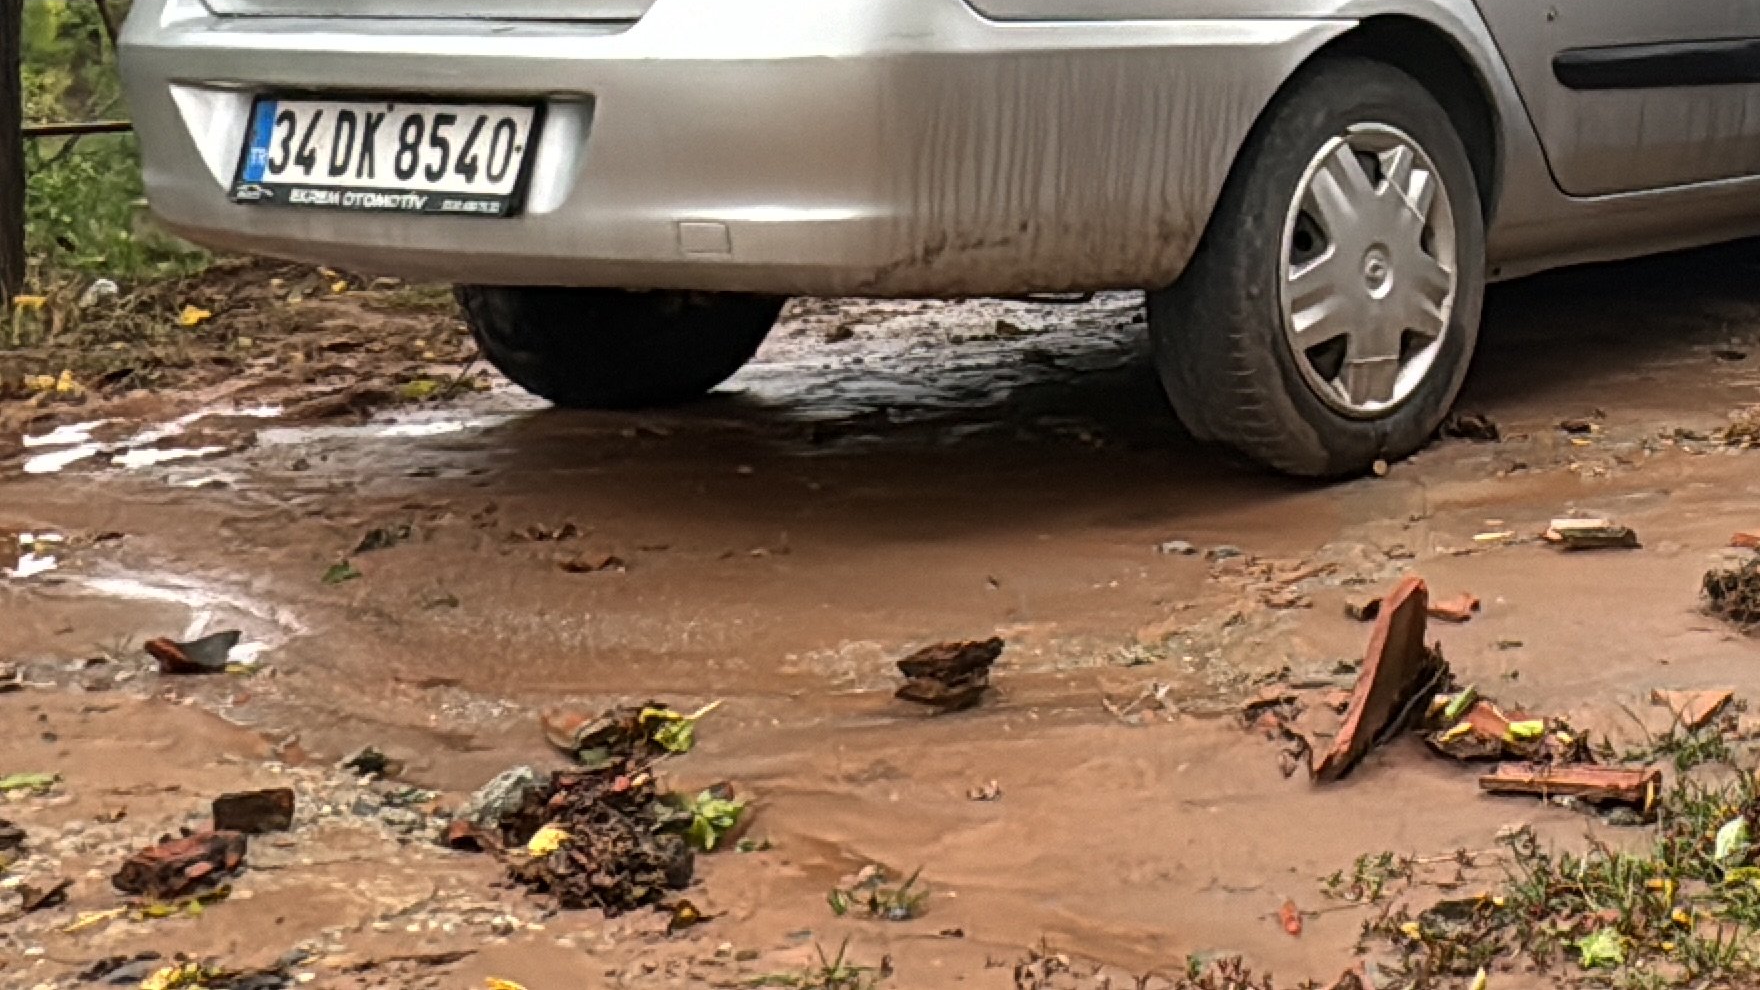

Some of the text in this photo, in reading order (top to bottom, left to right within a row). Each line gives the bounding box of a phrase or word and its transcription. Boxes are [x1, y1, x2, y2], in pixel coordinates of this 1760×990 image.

[251, 147, 267, 163] TR
[268, 109, 517, 183] 34 DK 8540
[288, 188, 340, 206] EKREM
